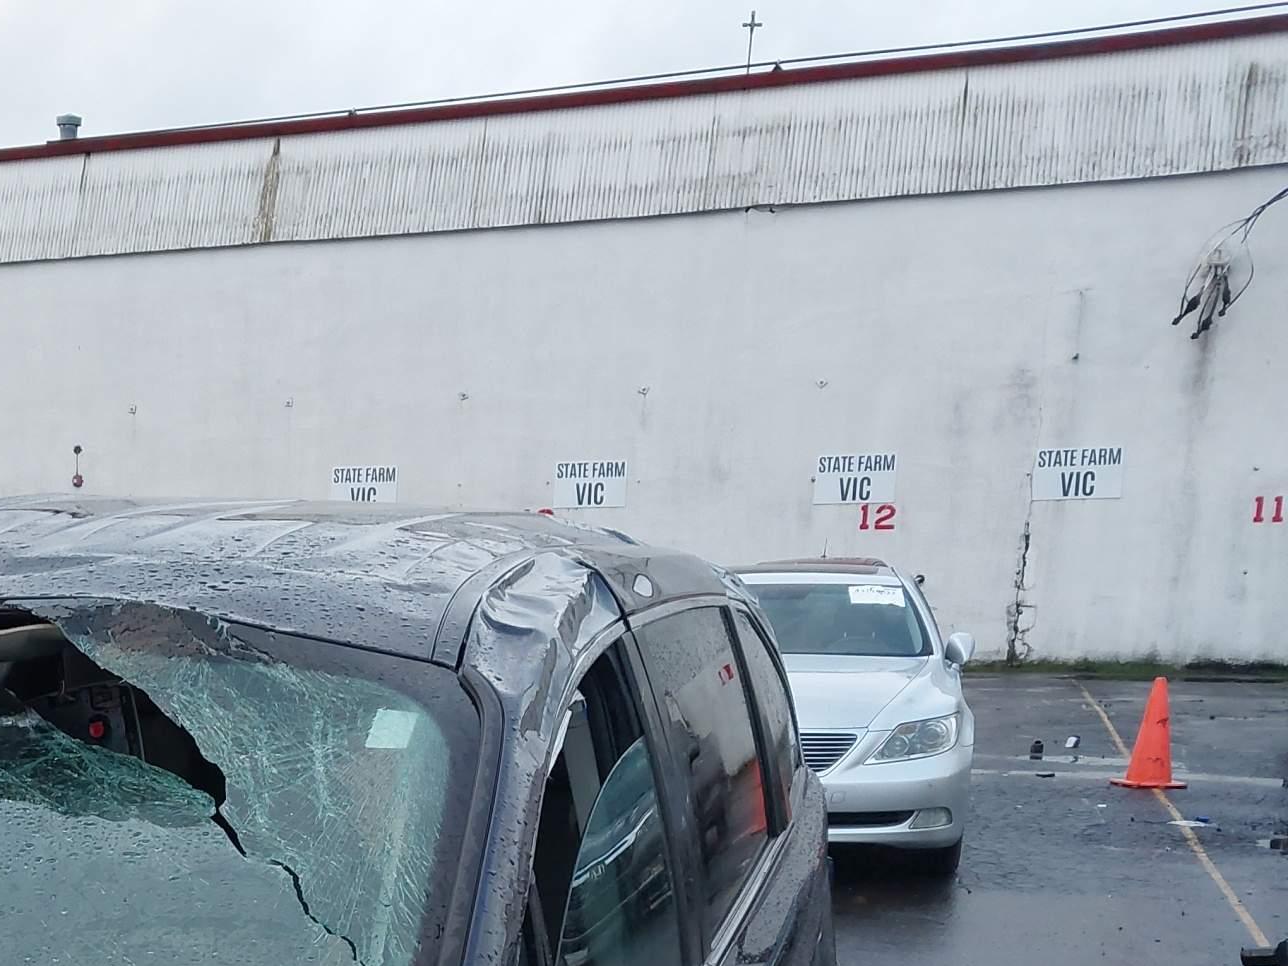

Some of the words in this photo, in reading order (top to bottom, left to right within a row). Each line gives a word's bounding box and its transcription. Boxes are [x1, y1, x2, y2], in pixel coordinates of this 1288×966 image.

[818, 455, 855, 473] STATE
[857, 454, 896, 472] FARM
[1037, 448, 1078, 468] STATE
[1081, 447, 1122, 466] FARM
[333, 467, 363, 484] STATE
[365, 466, 397, 483] FARM
[556, 462, 589, 479] STATE
[592, 461, 626, 478] FARM
[575, 482, 605, 506] VIC
[839, 476, 872, 502] VIC
[1061, 470, 1096, 497] VIC
[859, 502, 897, 531] 12
[1252, 495, 1284, 523] 11
